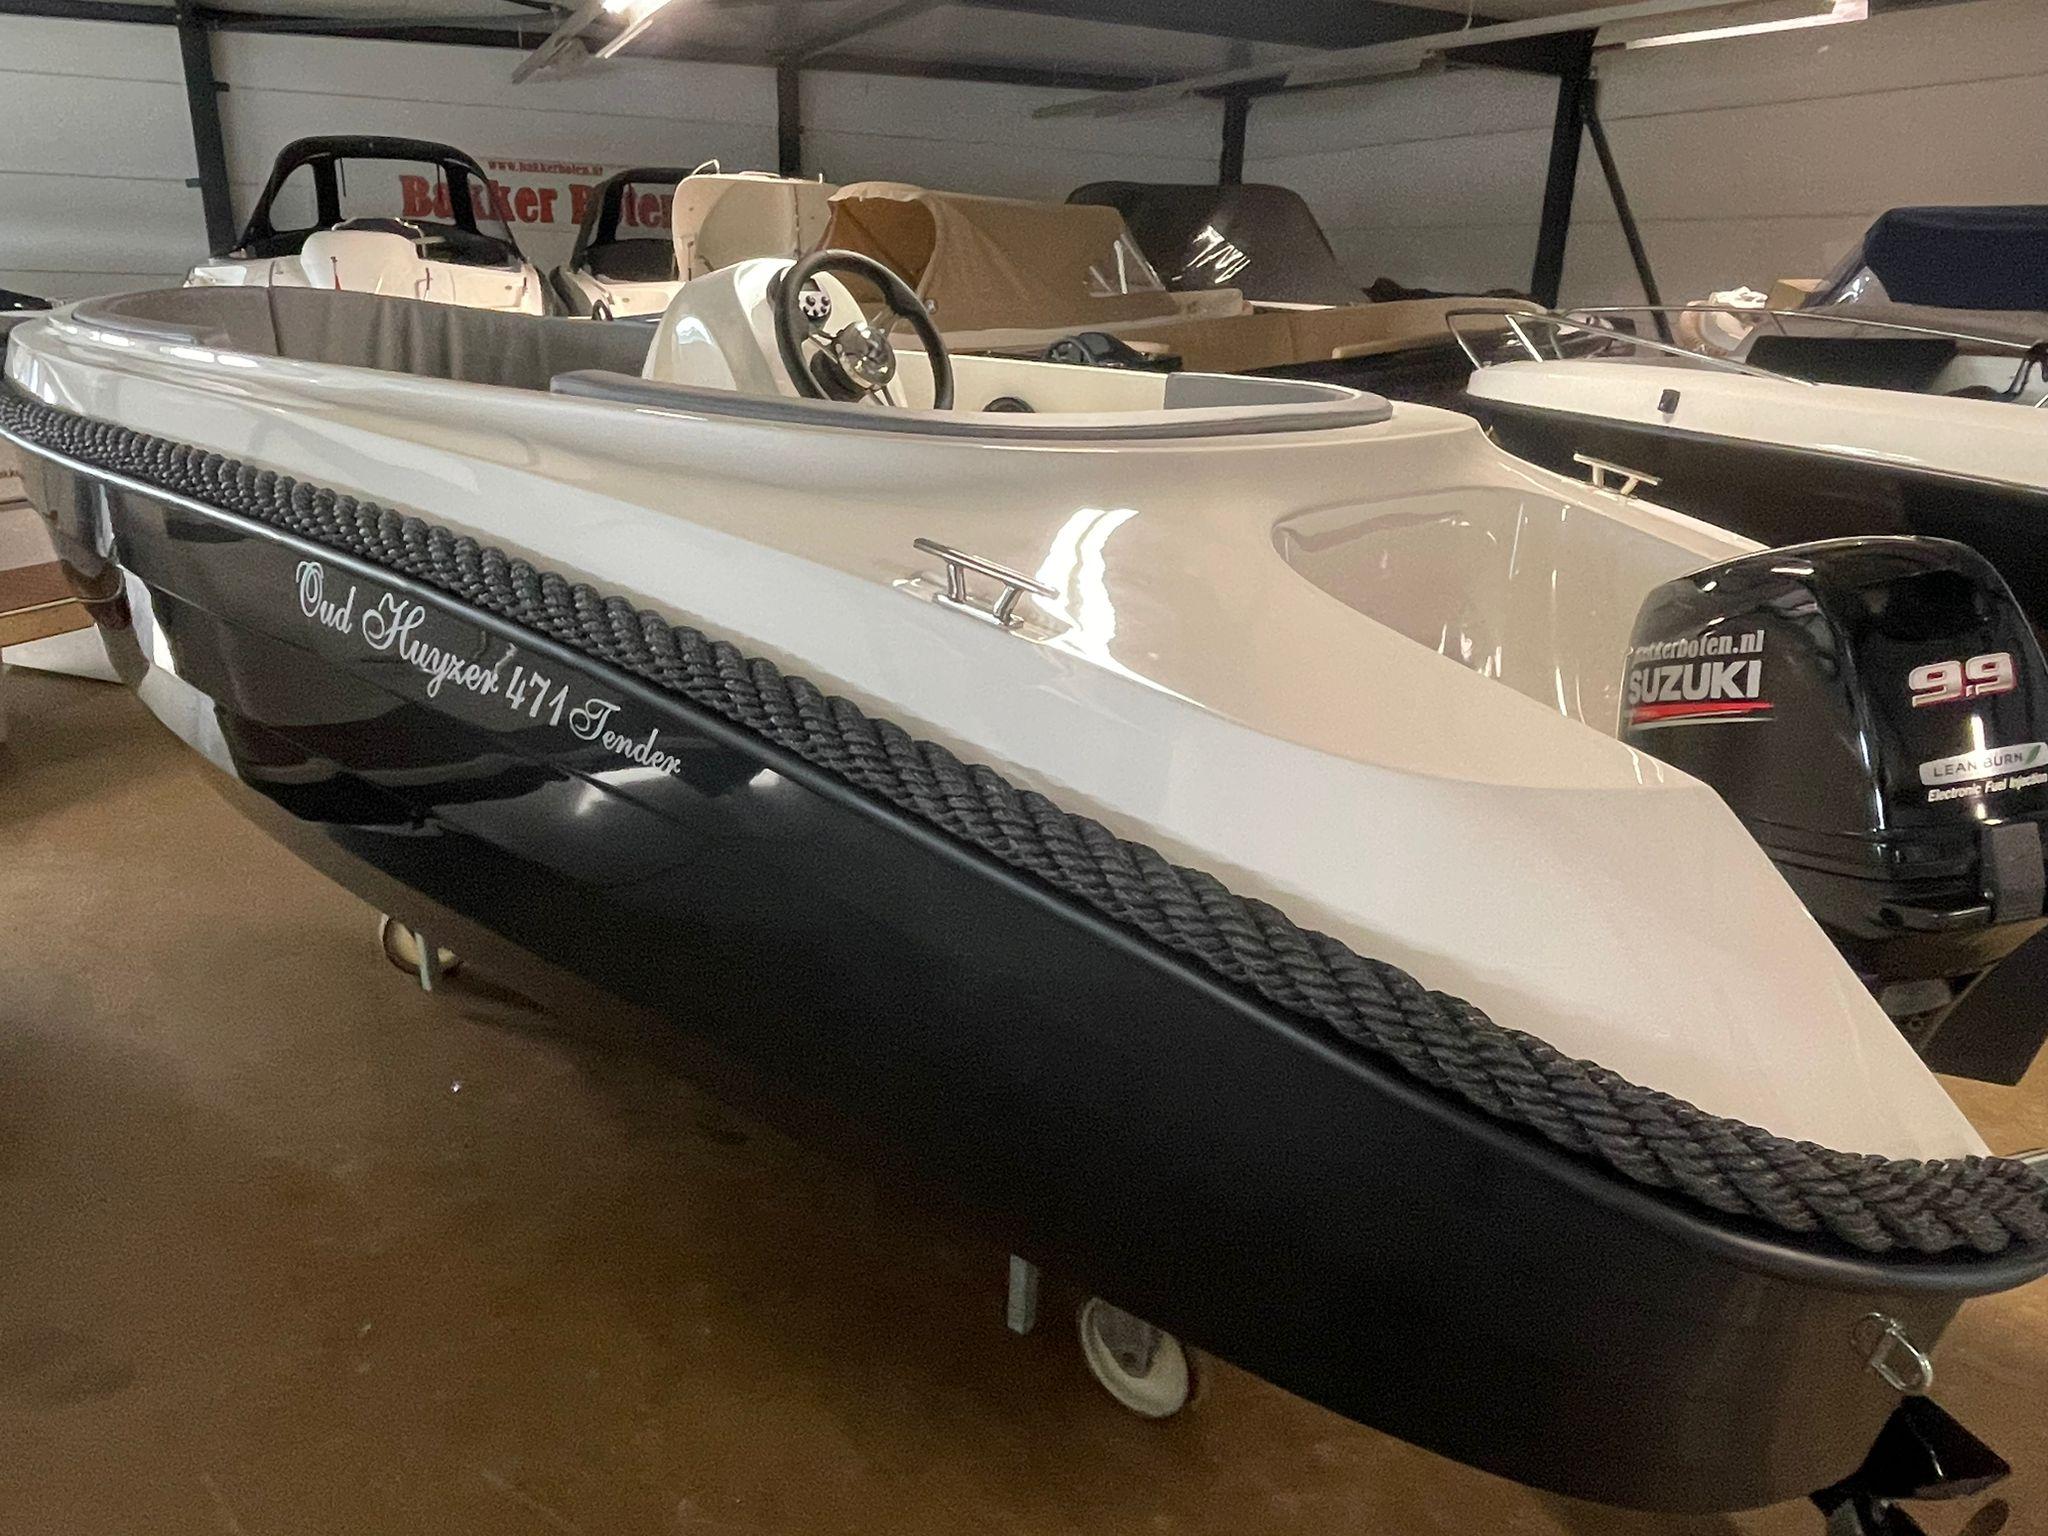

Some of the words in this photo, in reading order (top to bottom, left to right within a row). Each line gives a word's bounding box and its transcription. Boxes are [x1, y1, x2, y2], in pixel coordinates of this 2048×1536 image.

[296, 560, 356, 634] Oud
[504, 665, 570, 727] 471
[1629, 659, 1762, 704] SUZUKI
[1933, 761, 1978, 777] LEAN
[1983, 752, 2023, 769] BURN
